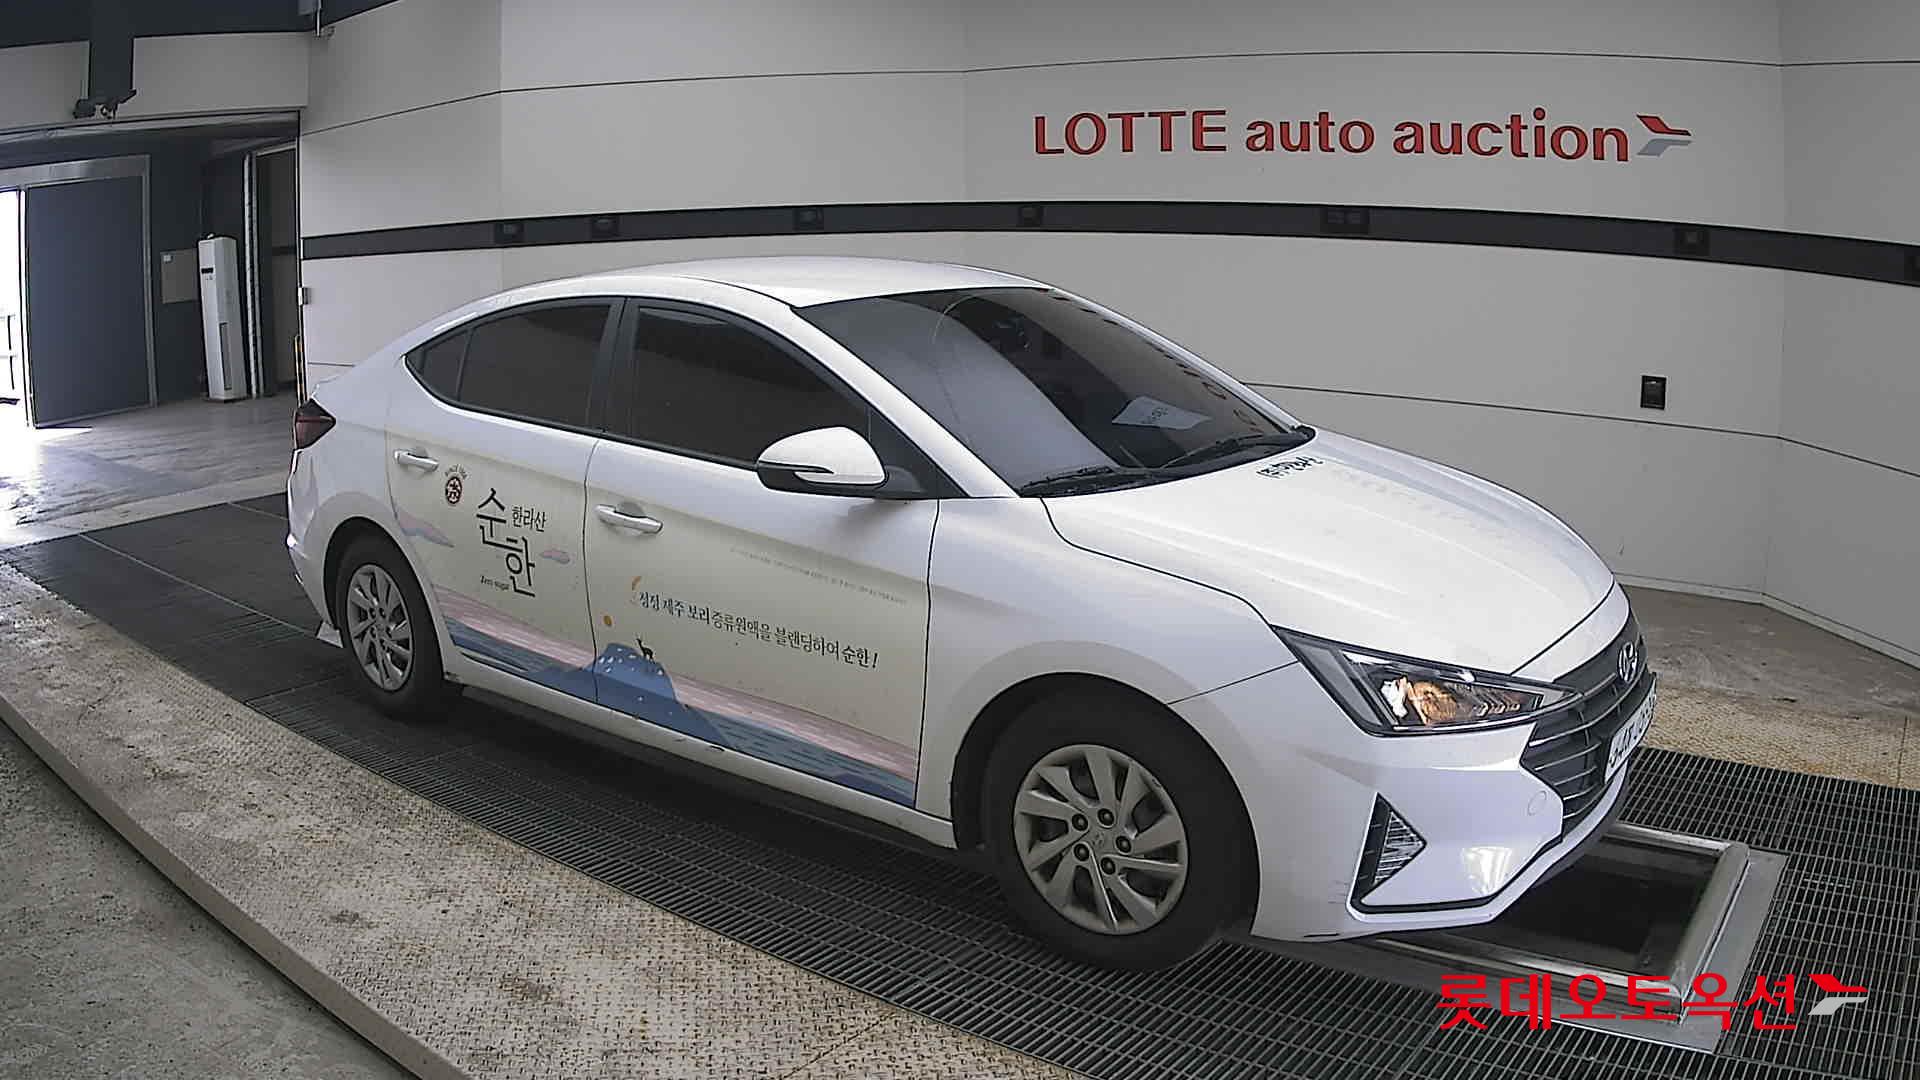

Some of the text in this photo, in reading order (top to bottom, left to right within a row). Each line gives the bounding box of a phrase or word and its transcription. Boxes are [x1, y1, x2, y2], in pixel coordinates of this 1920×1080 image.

[1034, 107, 1630, 163] LOTTE auto auction
[510, 505, 547, 533] 한라산
[663, 598, 686, 618] 제주
